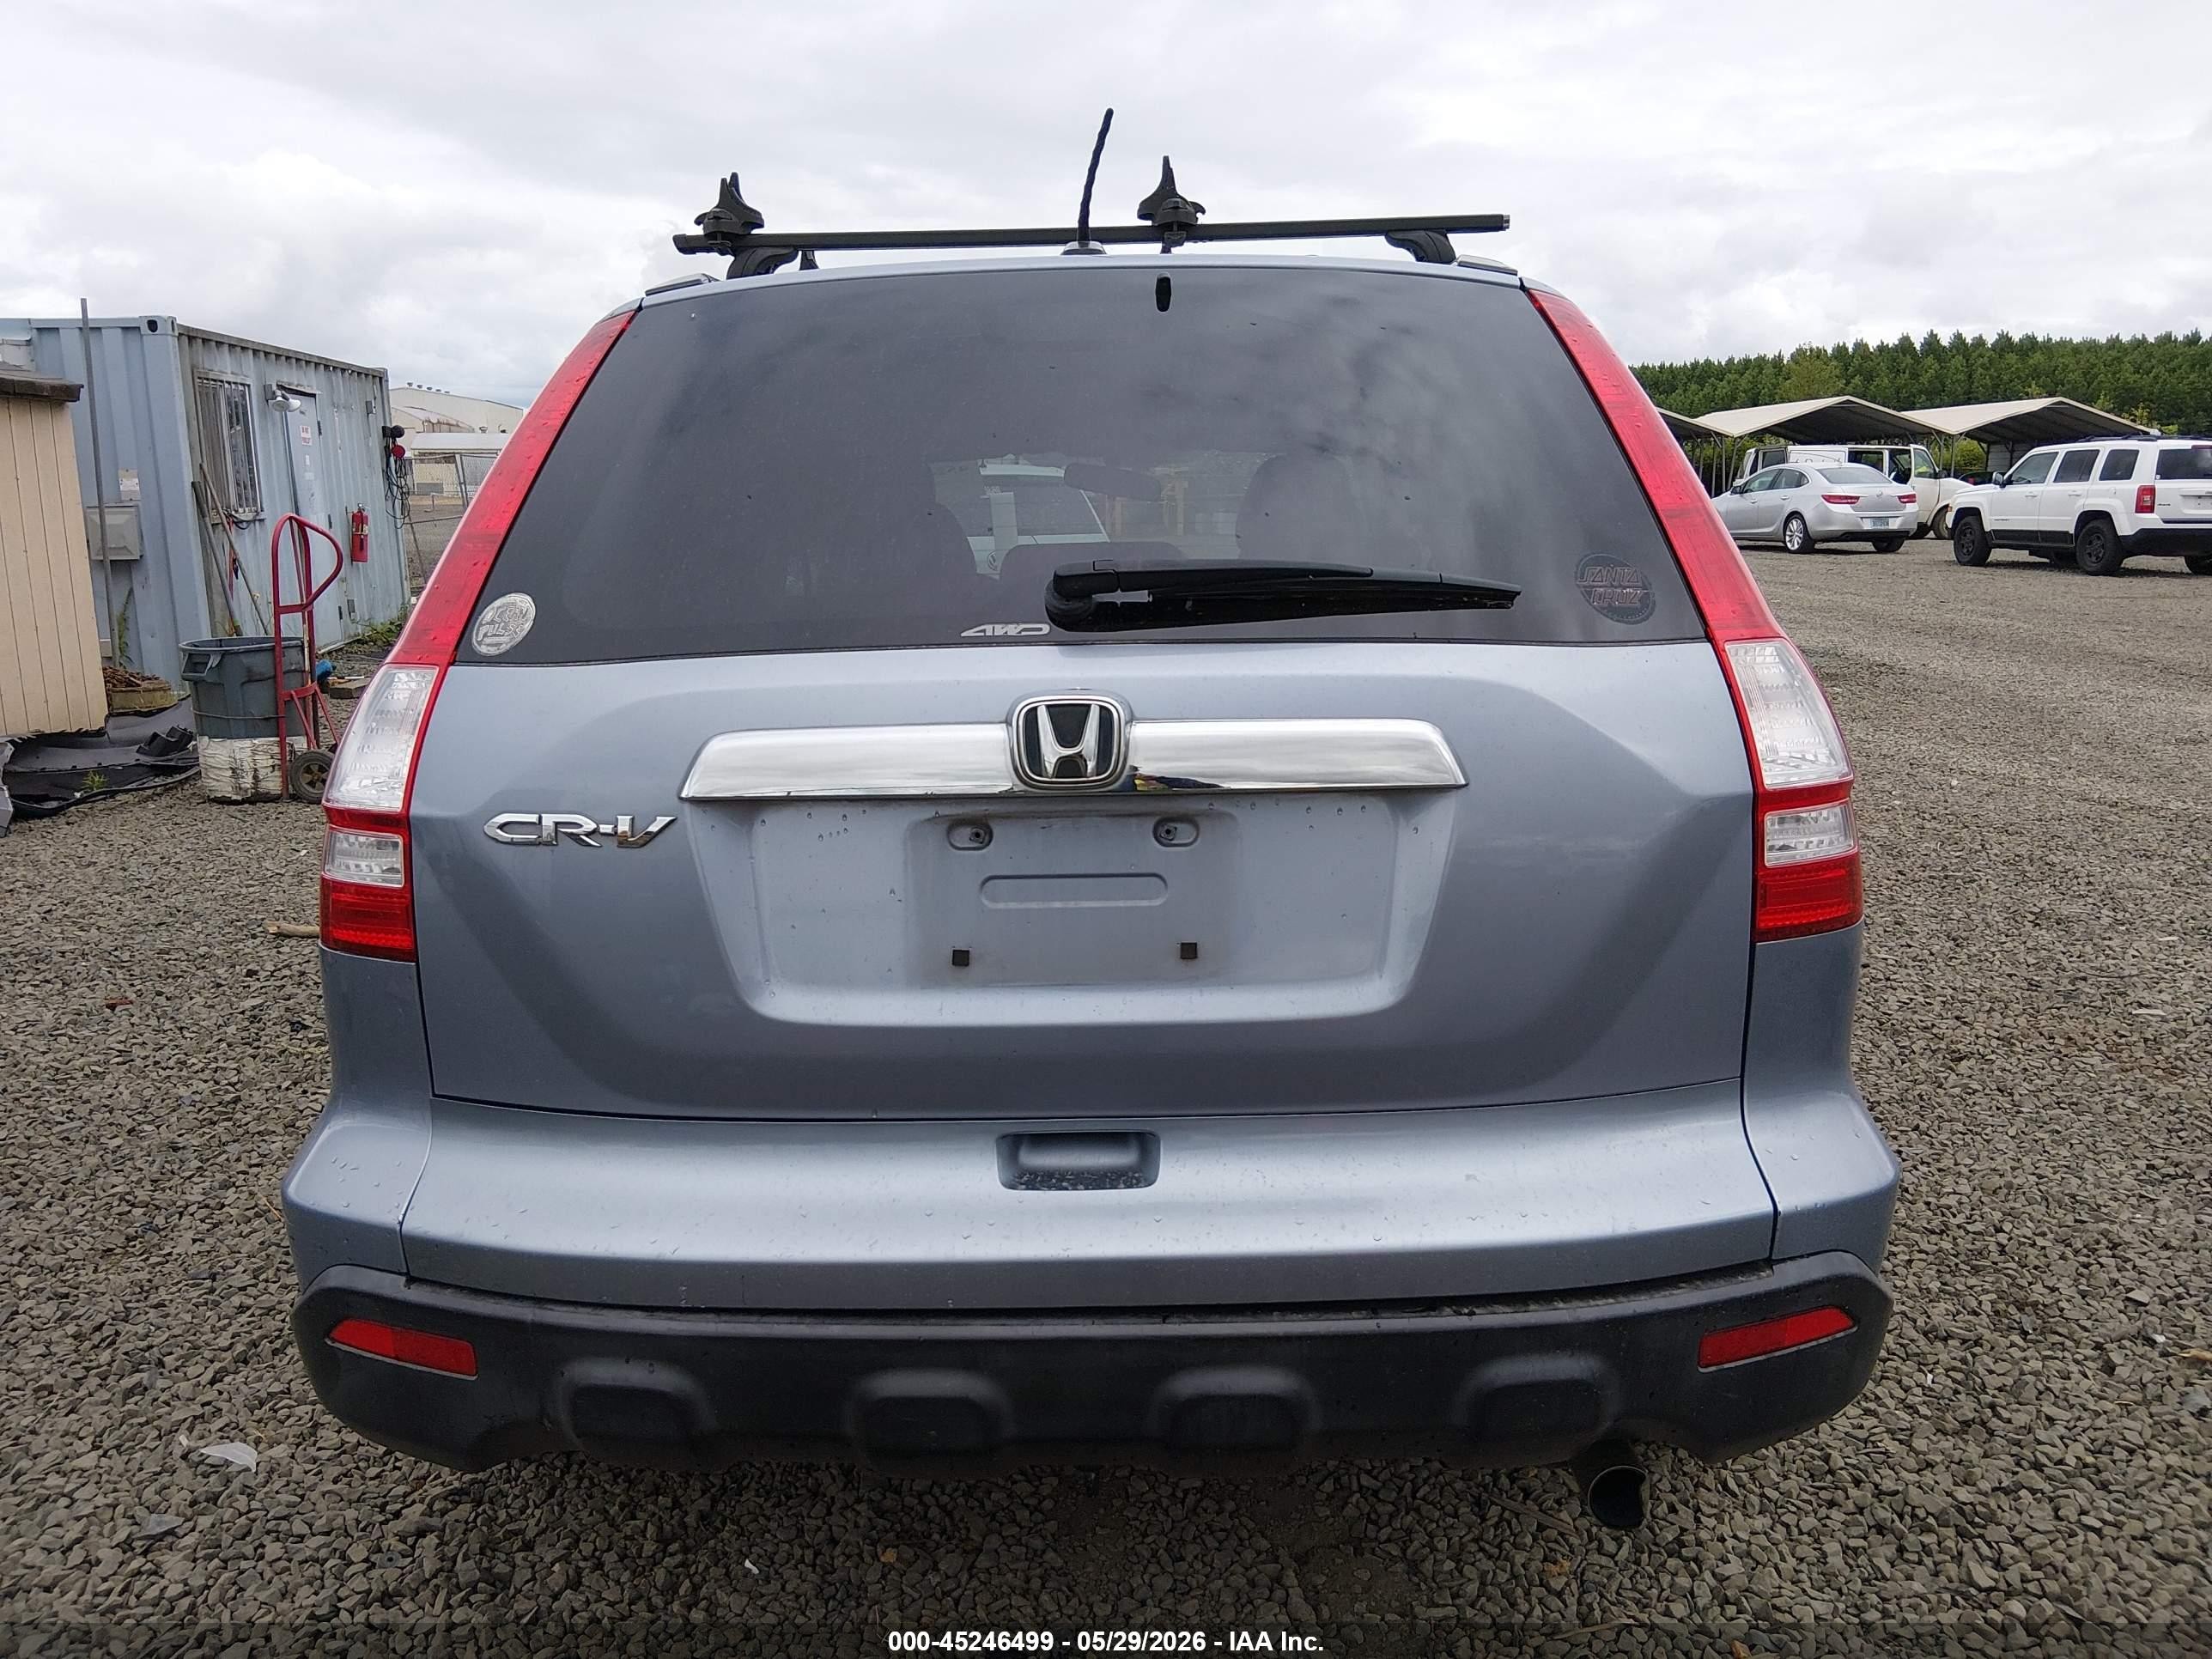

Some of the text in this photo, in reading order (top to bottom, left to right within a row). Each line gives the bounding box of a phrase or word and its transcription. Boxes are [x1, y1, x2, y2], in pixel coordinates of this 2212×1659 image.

[1577, 565, 1643, 585] SANTA
[1590, 587, 1644, 605] CRUZ
[483, 812, 678, 848] CR-V
